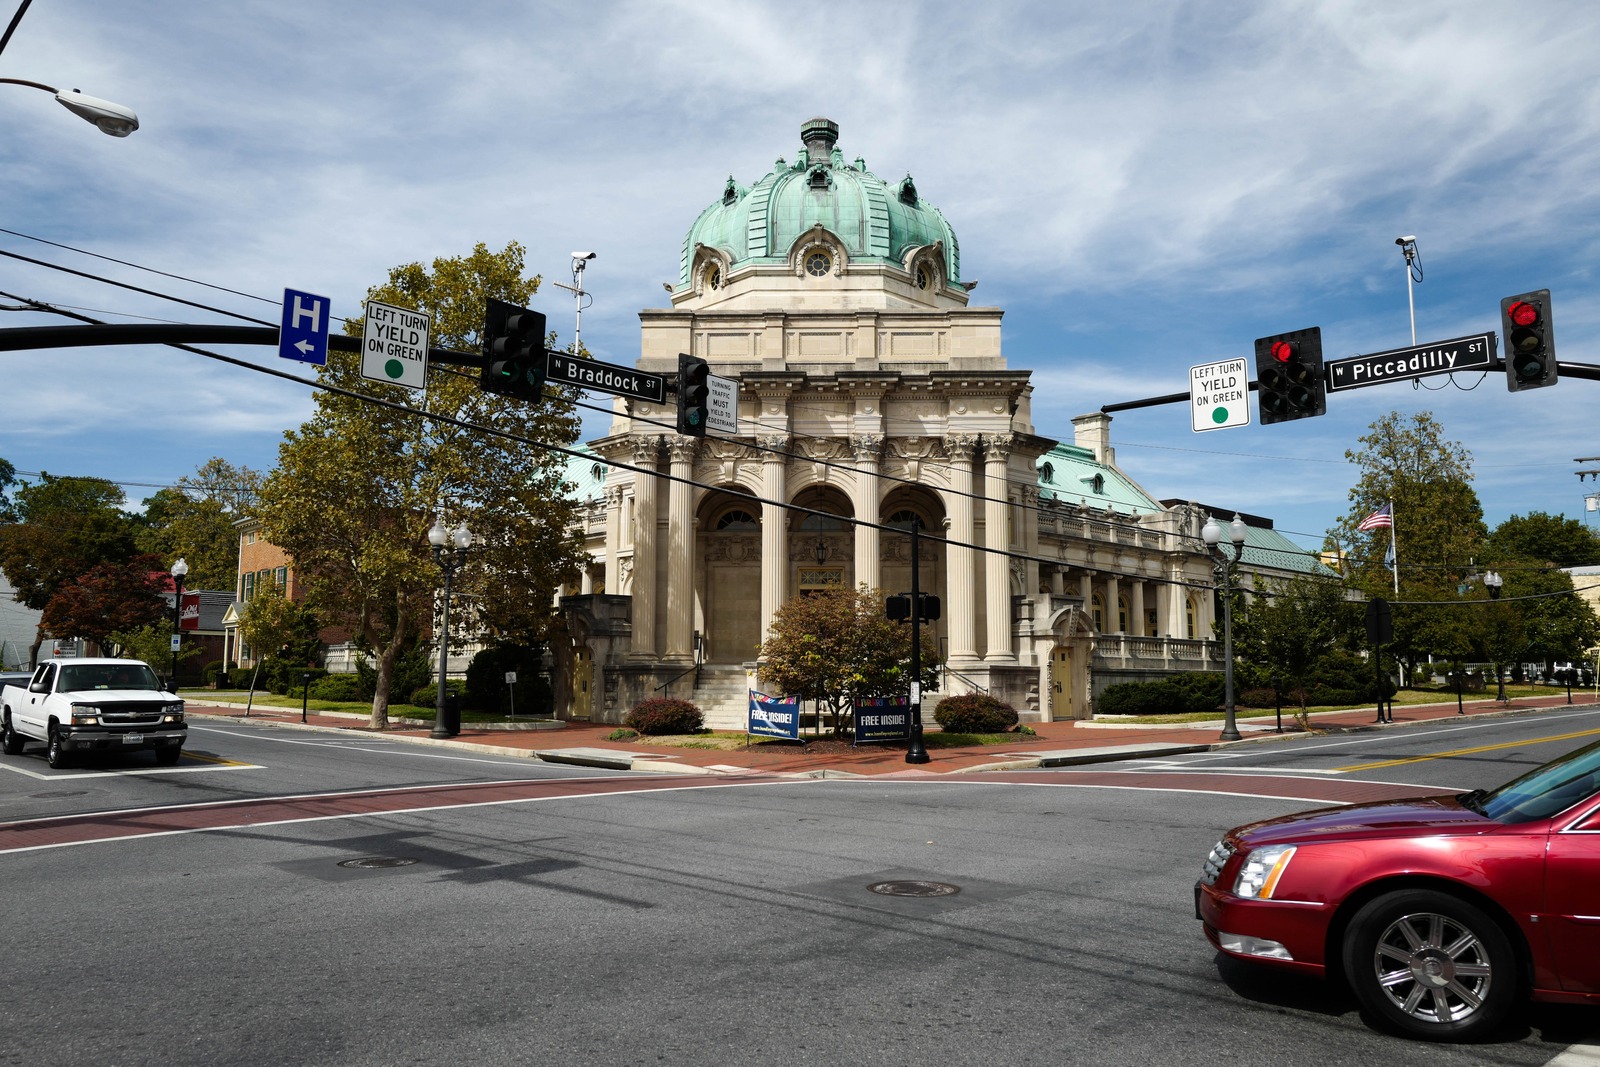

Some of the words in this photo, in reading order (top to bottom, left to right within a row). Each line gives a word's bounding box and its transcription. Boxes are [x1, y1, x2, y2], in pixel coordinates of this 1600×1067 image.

[292, 295, 321, 332] H
[369, 306, 396, 323] LEFT
[400, 313, 427, 331] TURN
[375, 322, 419, 345] YIELD
[369, 339, 384, 353] ON
[387, 343, 422, 362] GREEN
[1336, 367, 1344, 376] W
[1353, 350, 1457, 380] Piccadilly
[1469, 342, 1482, 353] ST
[555, 360, 561, 368] N
[568, 363, 639, 392] Braddock
[646, 380, 656, 389] ST
[1194, 366, 1215, 379] LEFT
[1219, 362, 1242, 374] TURN
[711, 380, 731, 391] TURNING
[1201, 376, 1236, 392] YIELD
[712, 389, 730, 400] TRAFFIC
[1197, 396, 1209, 406] ON
[1213, 390, 1243, 404] GREEN
[713, 399, 729, 409] MUST
[710, 408, 724, 417] YIELD
[725, 411, 731, 419] TO
[751, 709, 768, 720] FREE
[769, 712, 792, 724] INSIDE!
[861, 715, 879, 726] FREE
[881, 714, 905, 725] INSIDE!
